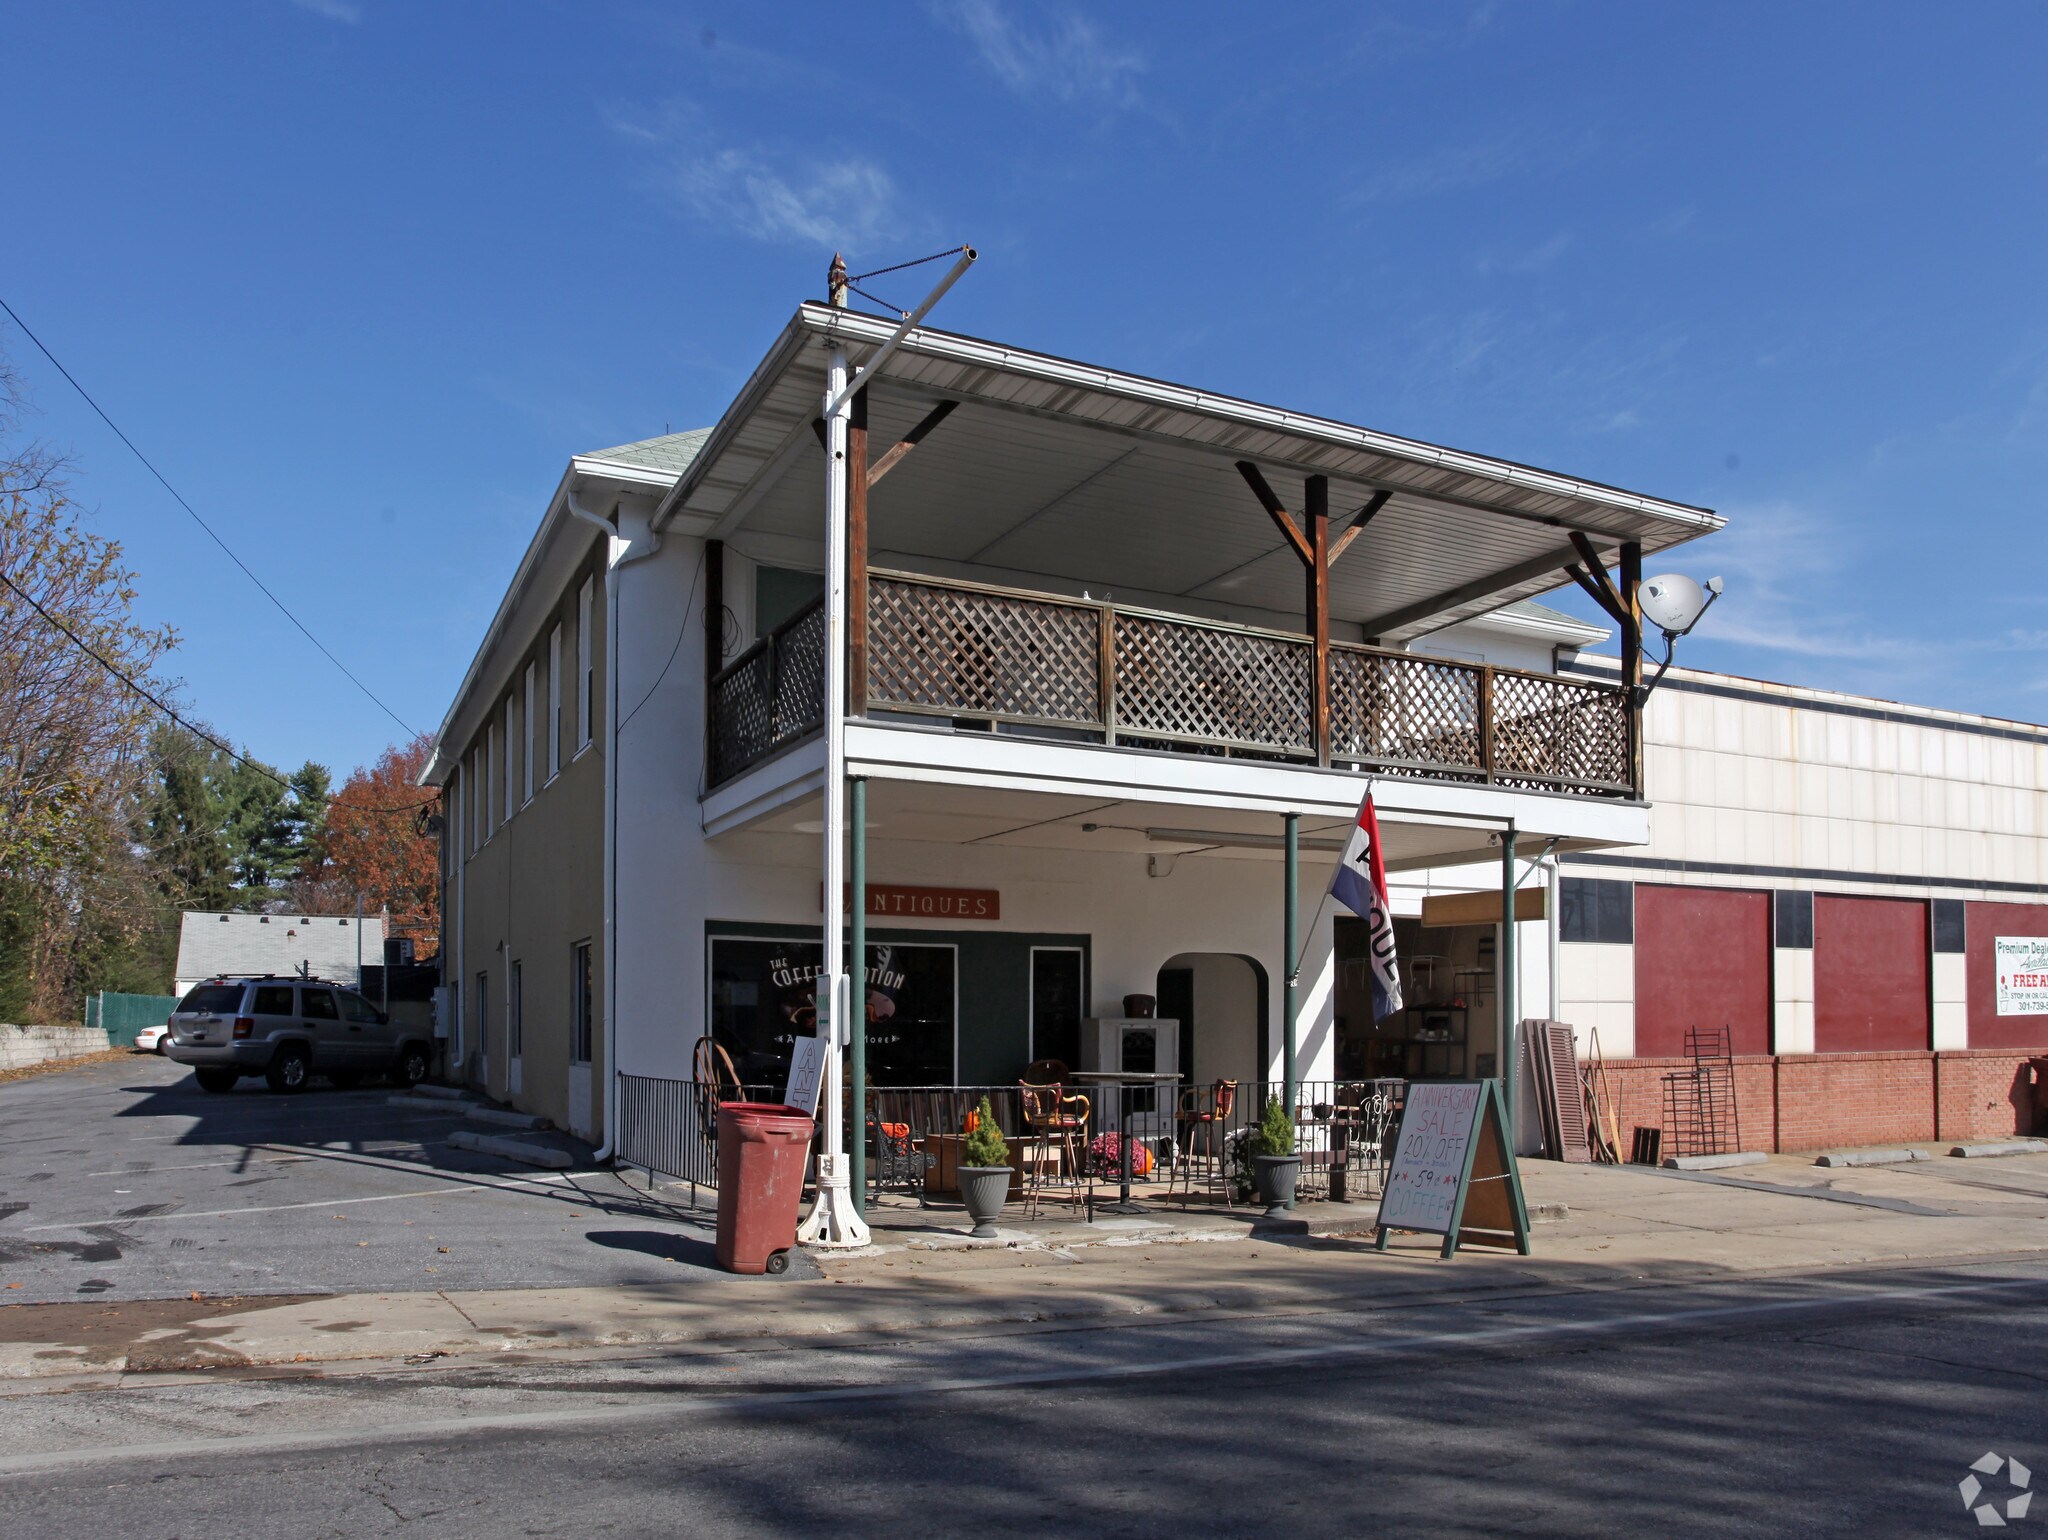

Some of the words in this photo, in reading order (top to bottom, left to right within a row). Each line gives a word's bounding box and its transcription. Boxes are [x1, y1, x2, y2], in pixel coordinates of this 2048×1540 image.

[864, 893, 988, 915] NTIQUES
[1997, 942, 2030, 954] Premium
[769, 957, 788, 970] THE
[2013, 974, 2038, 987] FREE
[1411, 1086, 1478, 1111] ANNIVERSARY
[1416, 1110, 1464, 1135] SALE
[1403, 1134, 1433, 1159] 20%
[1435, 1137, 1464, 1161] OFF
[1389, 1187, 1447, 1220] COFFEE
